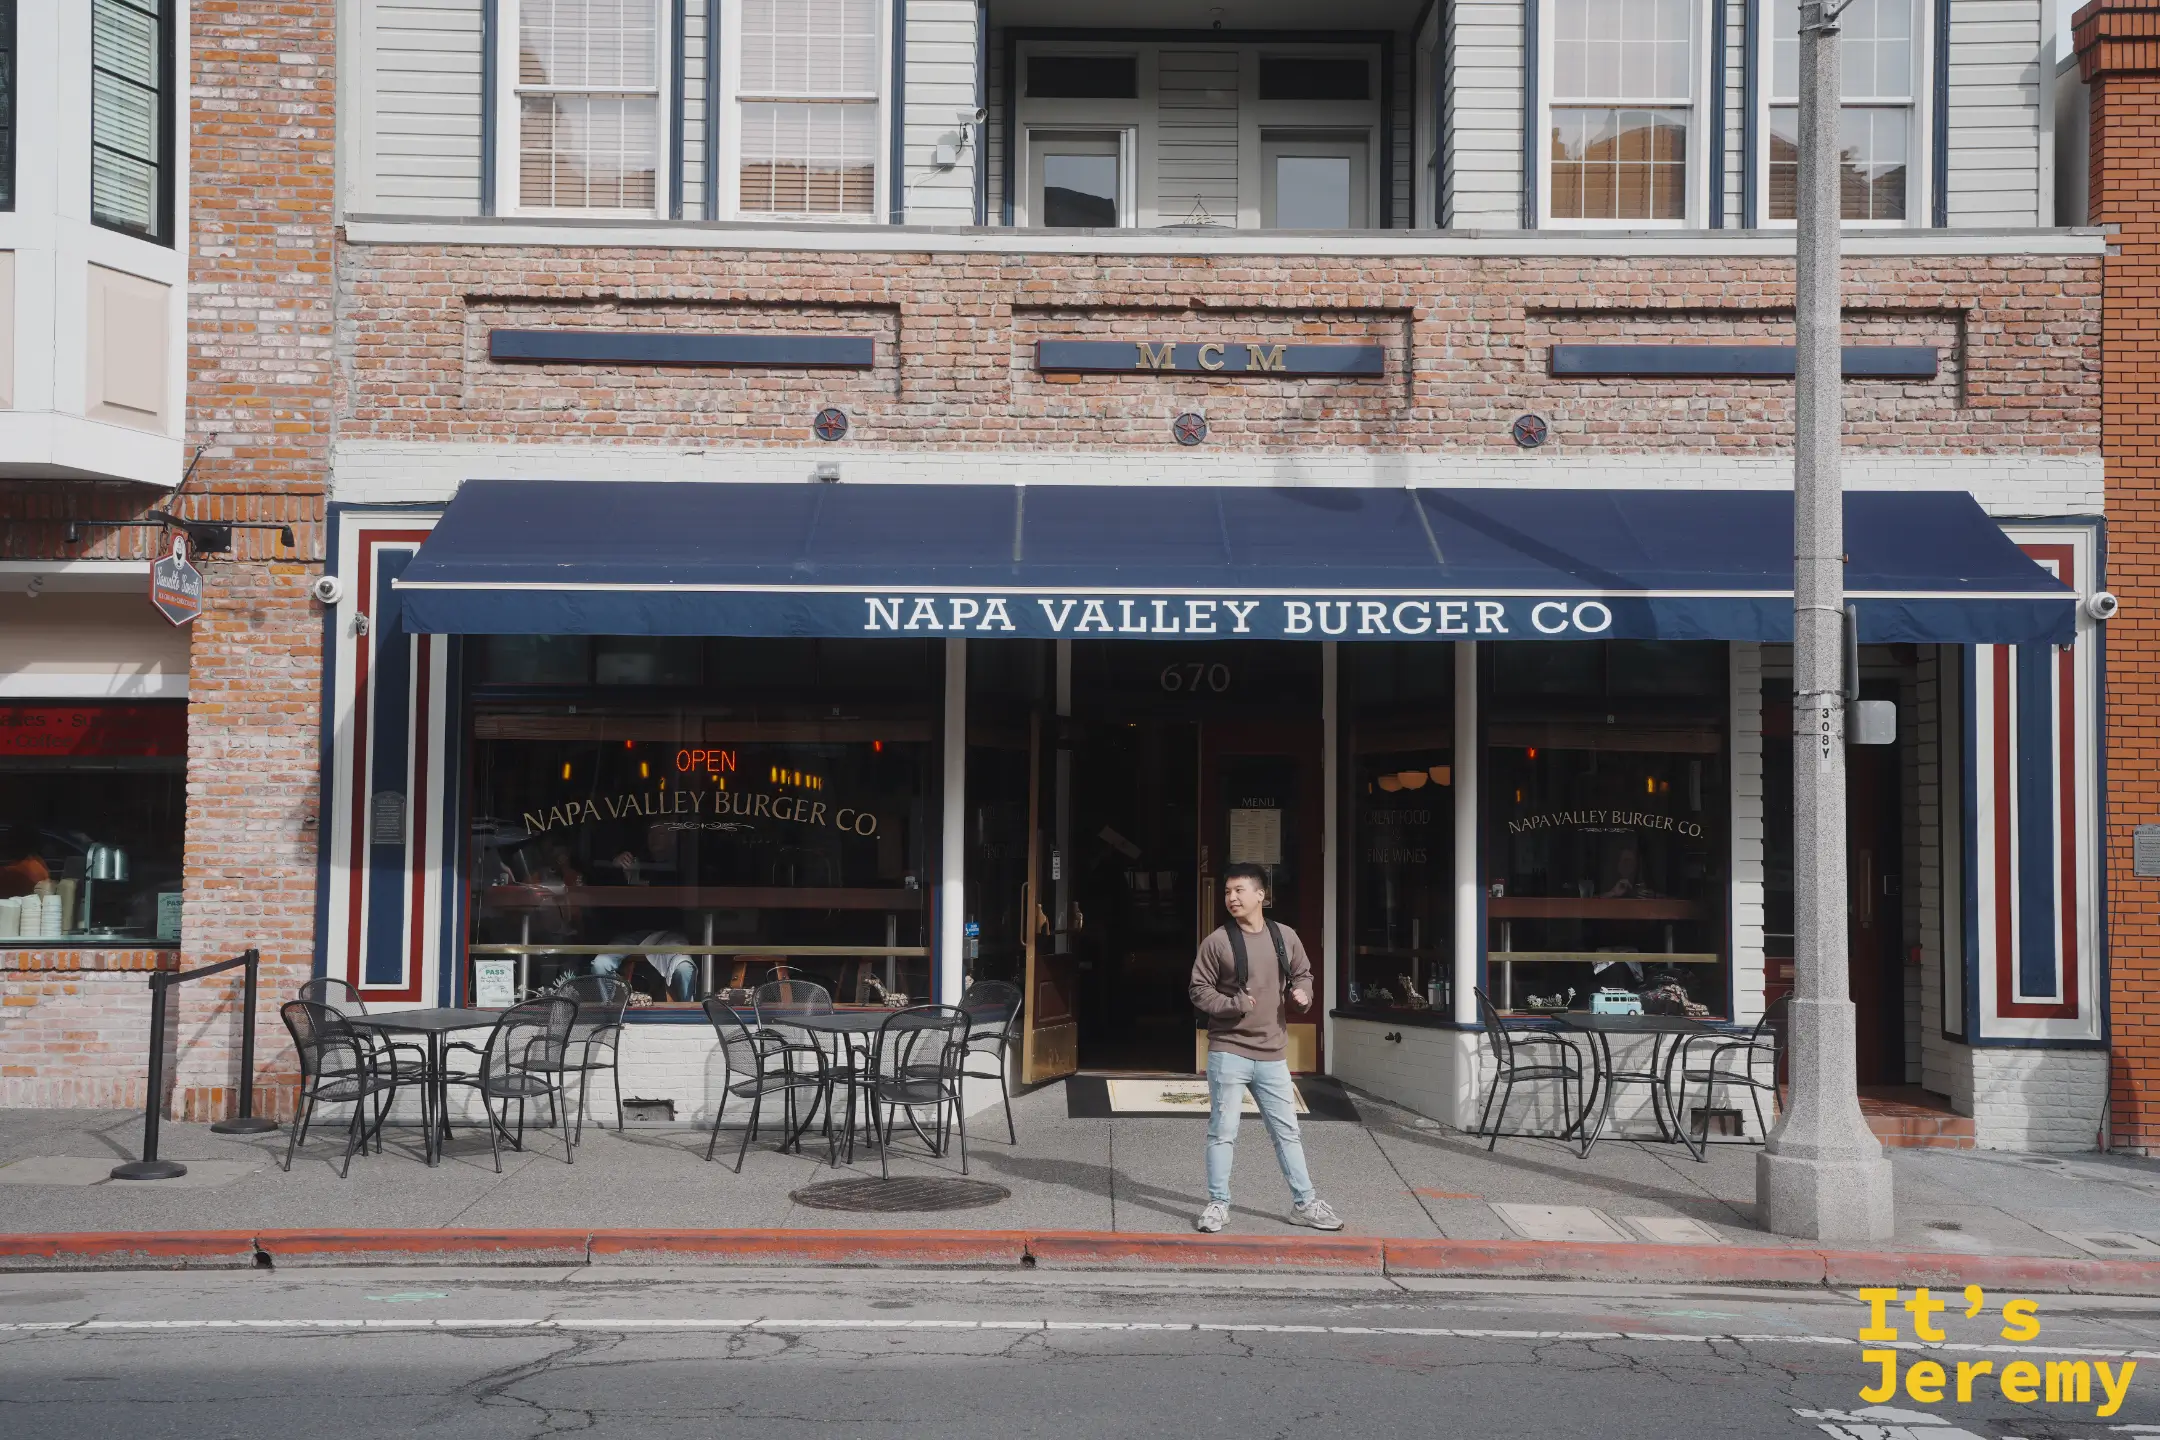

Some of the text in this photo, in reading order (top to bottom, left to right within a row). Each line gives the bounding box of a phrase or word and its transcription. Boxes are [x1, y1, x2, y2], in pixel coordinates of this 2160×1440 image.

[864, 597, 1612, 635] NAPA VALLEY BURGER CO
[1161, 663, 1231, 692] 670
[15, 733, 74, 748] Coffee
[1821, 708, 1830, 759] 308Y
[676, 750, 736, 772] OPEN
[1241, 797, 1275, 807] MENU
[523, 791, 881, 839] NAPA VALLEY BURGER CO.
[1399, 809, 1431, 825] FOOD
[1508, 810, 1704, 839] NAPA VALLEY BURGER CO.
[1367, 847, 1428, 864] FINE WINES
